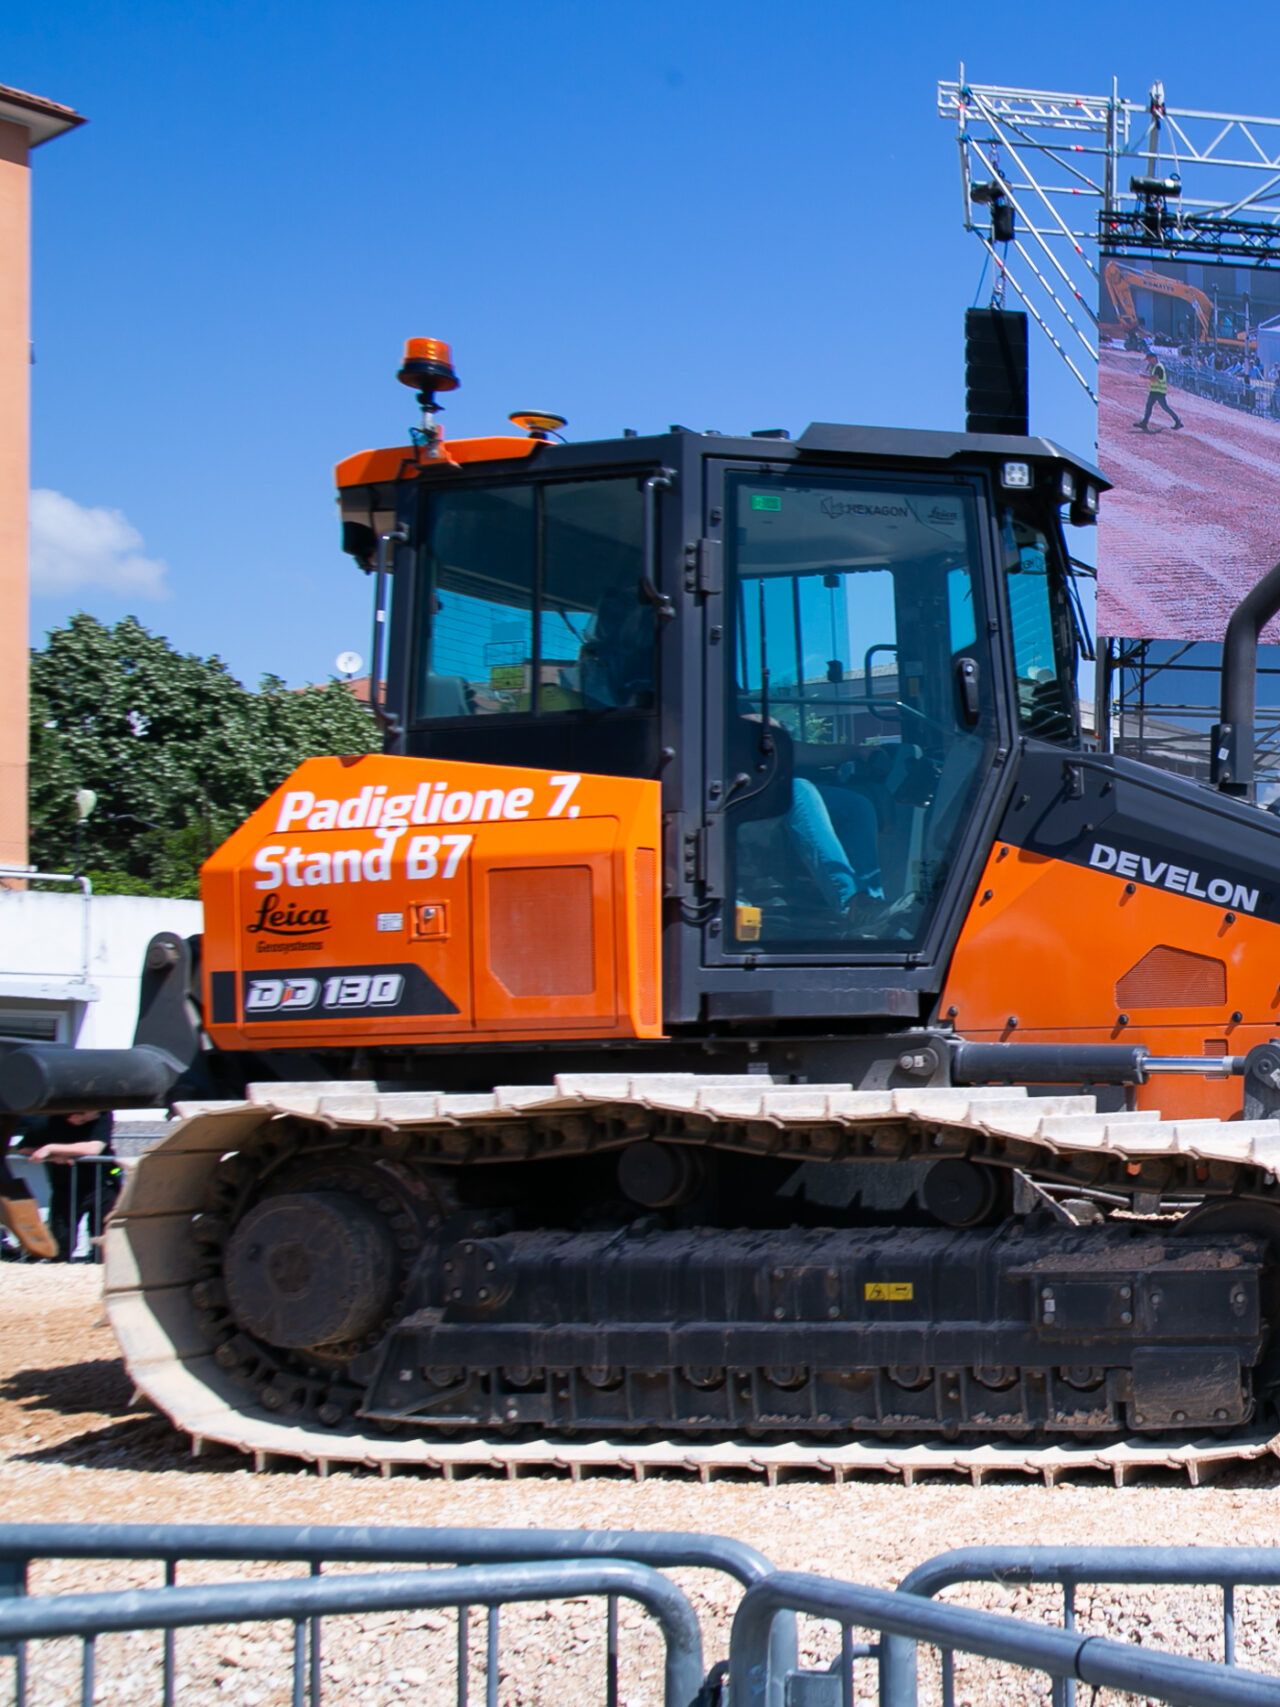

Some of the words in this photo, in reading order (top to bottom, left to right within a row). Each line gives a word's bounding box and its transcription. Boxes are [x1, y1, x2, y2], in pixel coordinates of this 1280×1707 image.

[275, 781, 534, 840] Padiglione
[254, 832, 392, 890] Stand
[406, 834, 473, 881] B7
[1089, 843, 1260, 913] DEVELON
[246, 893, 332, 936] Leica
[246, 978, 321, 1012] DD
[323, 974, 406, 1009] 130
